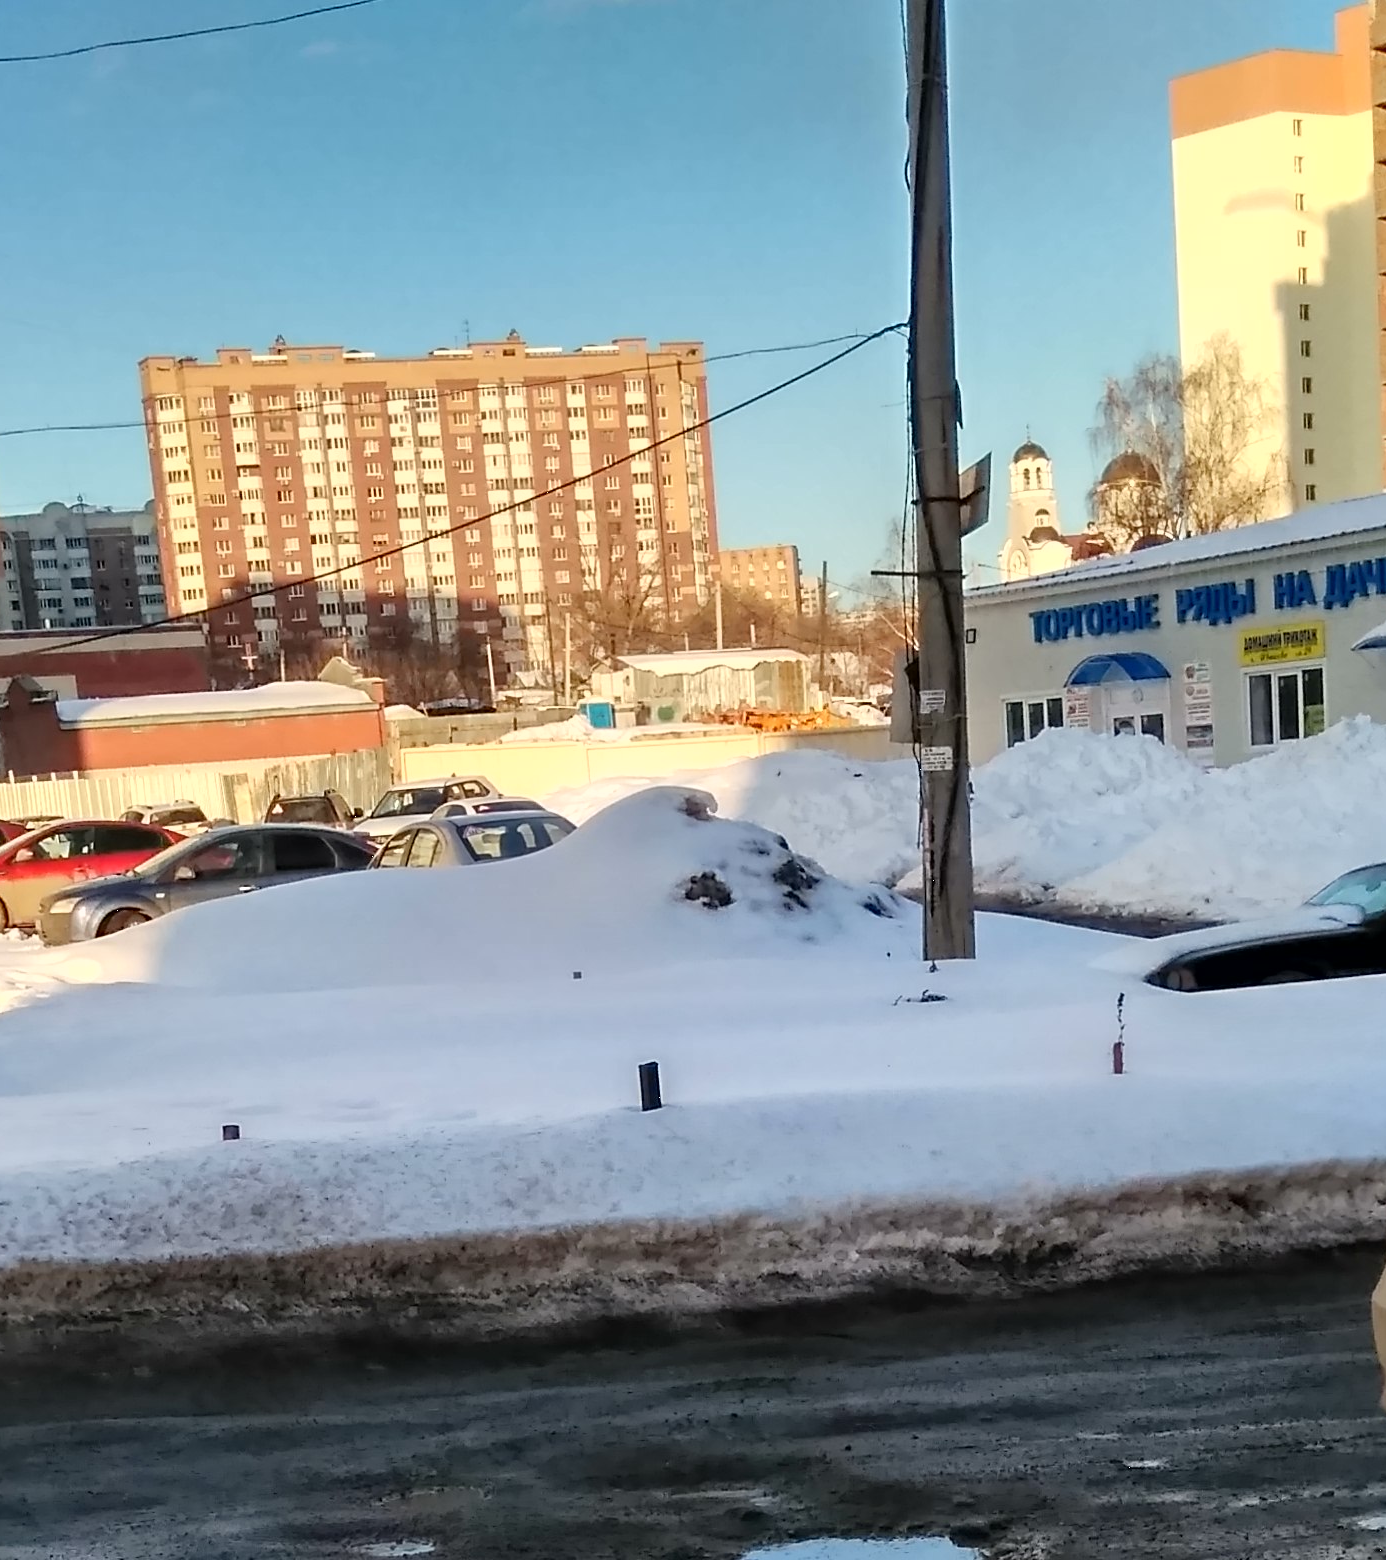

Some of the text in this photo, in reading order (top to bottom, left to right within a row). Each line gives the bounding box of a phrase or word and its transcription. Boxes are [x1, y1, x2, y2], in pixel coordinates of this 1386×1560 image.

[1029, 593, 1161, 643] ТОРГОВЫЕ
[1175, 578, 1256, 626] РЯДЫ
[1274, 569, 1317, 610] НА
